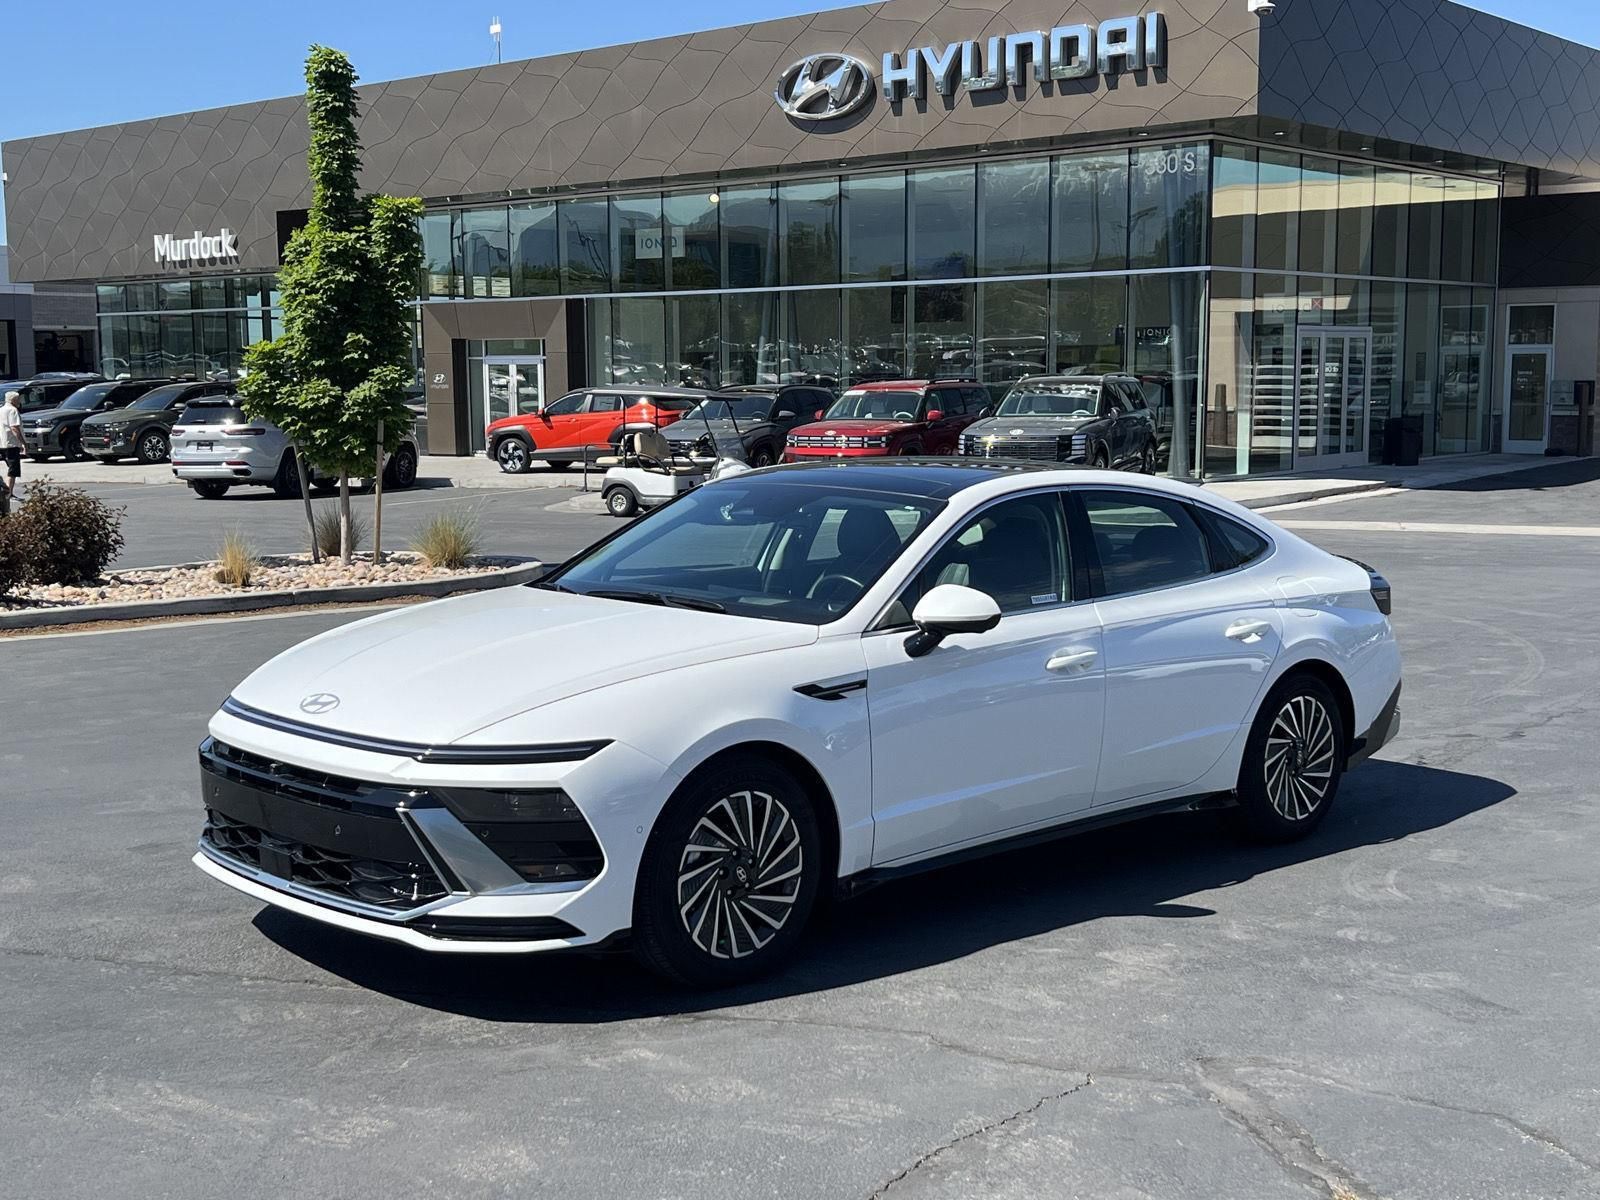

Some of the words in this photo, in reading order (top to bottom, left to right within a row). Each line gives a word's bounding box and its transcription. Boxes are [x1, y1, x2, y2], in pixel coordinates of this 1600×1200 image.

[882, 11, 1165, 103] HYUNDAI
[1184, 152, 1195, 172] S
[153, 228, 238, 263] Murdock
[641, 237, 677, 249] IONQ
